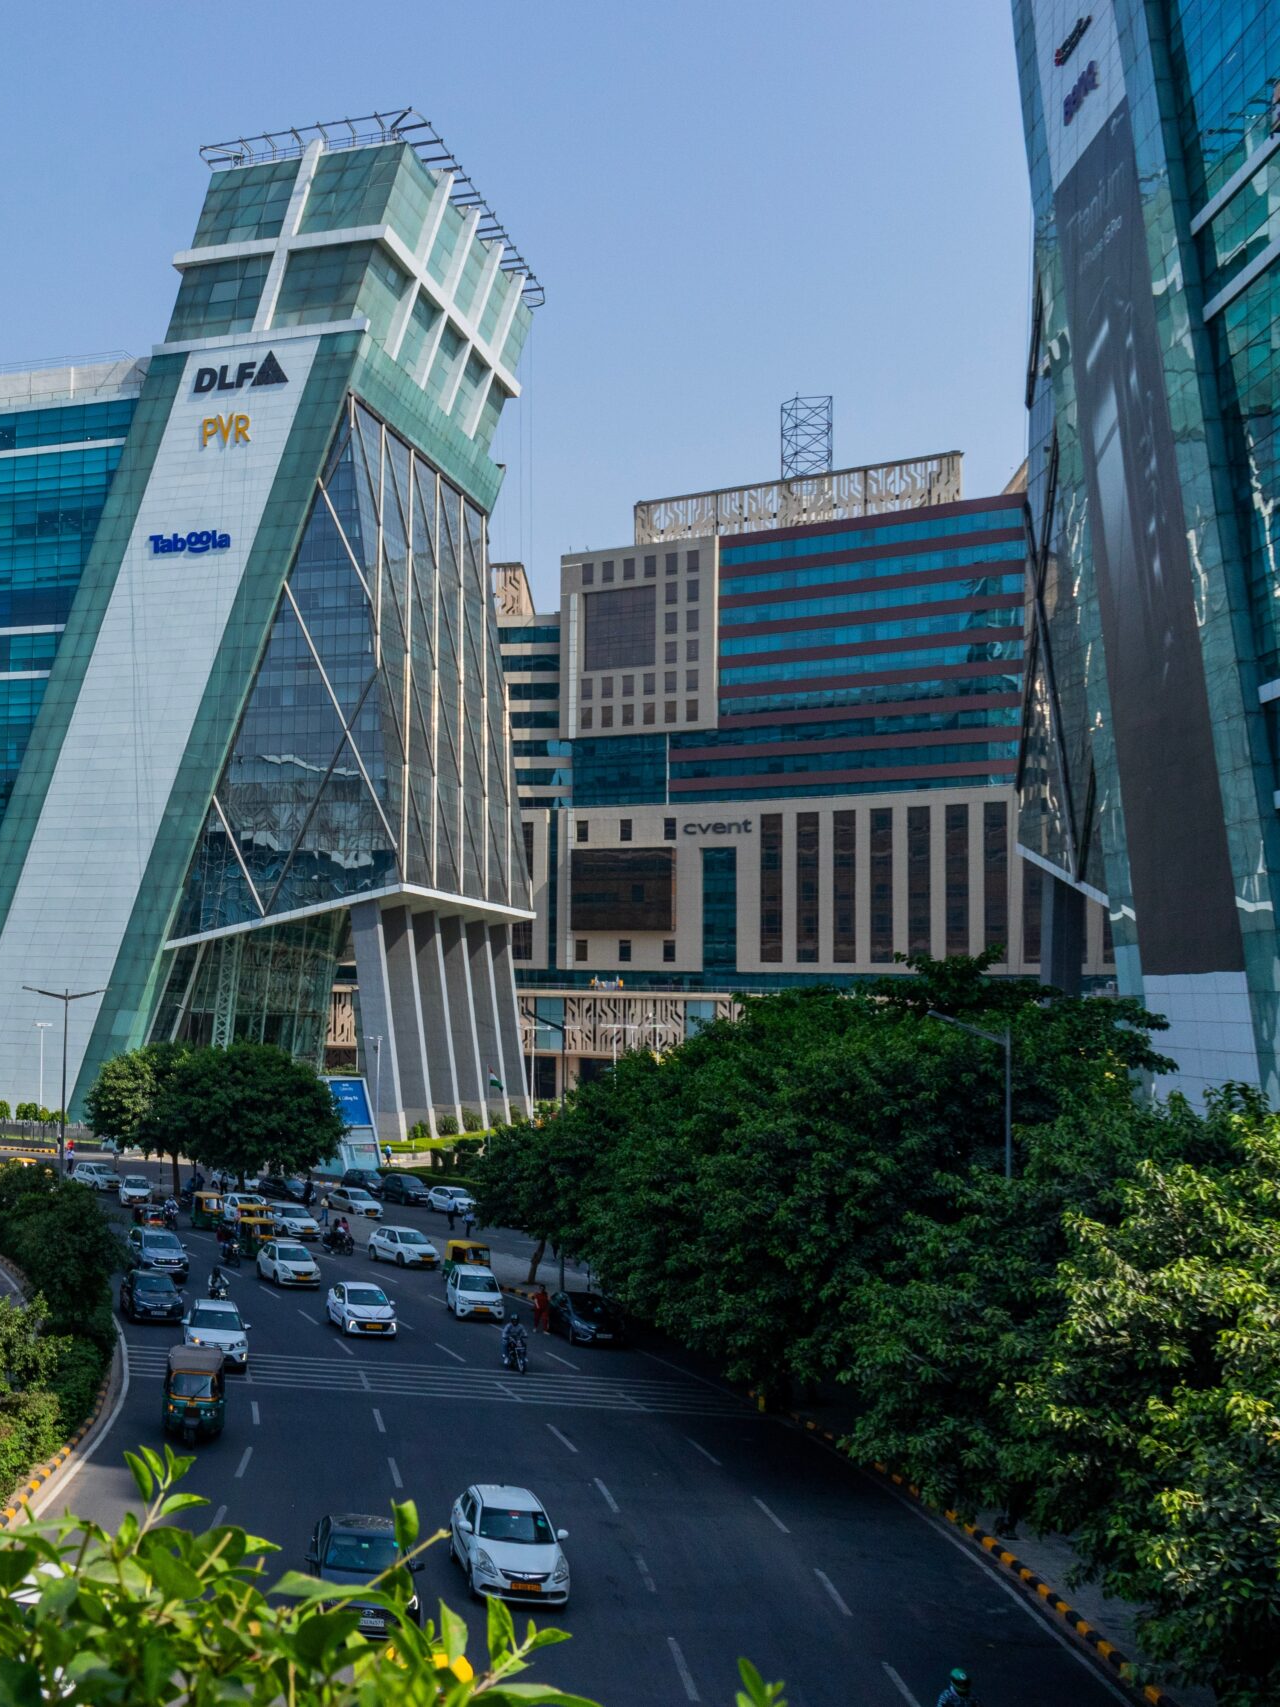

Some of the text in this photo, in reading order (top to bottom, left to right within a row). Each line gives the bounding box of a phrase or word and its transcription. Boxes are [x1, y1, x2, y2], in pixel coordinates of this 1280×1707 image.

[193, 361, 256, 393] DLF
[202, 412, 251, 447] PVR
[149, 530, 231, 554] Taboola
[683, 818, 753, 836] cvent
